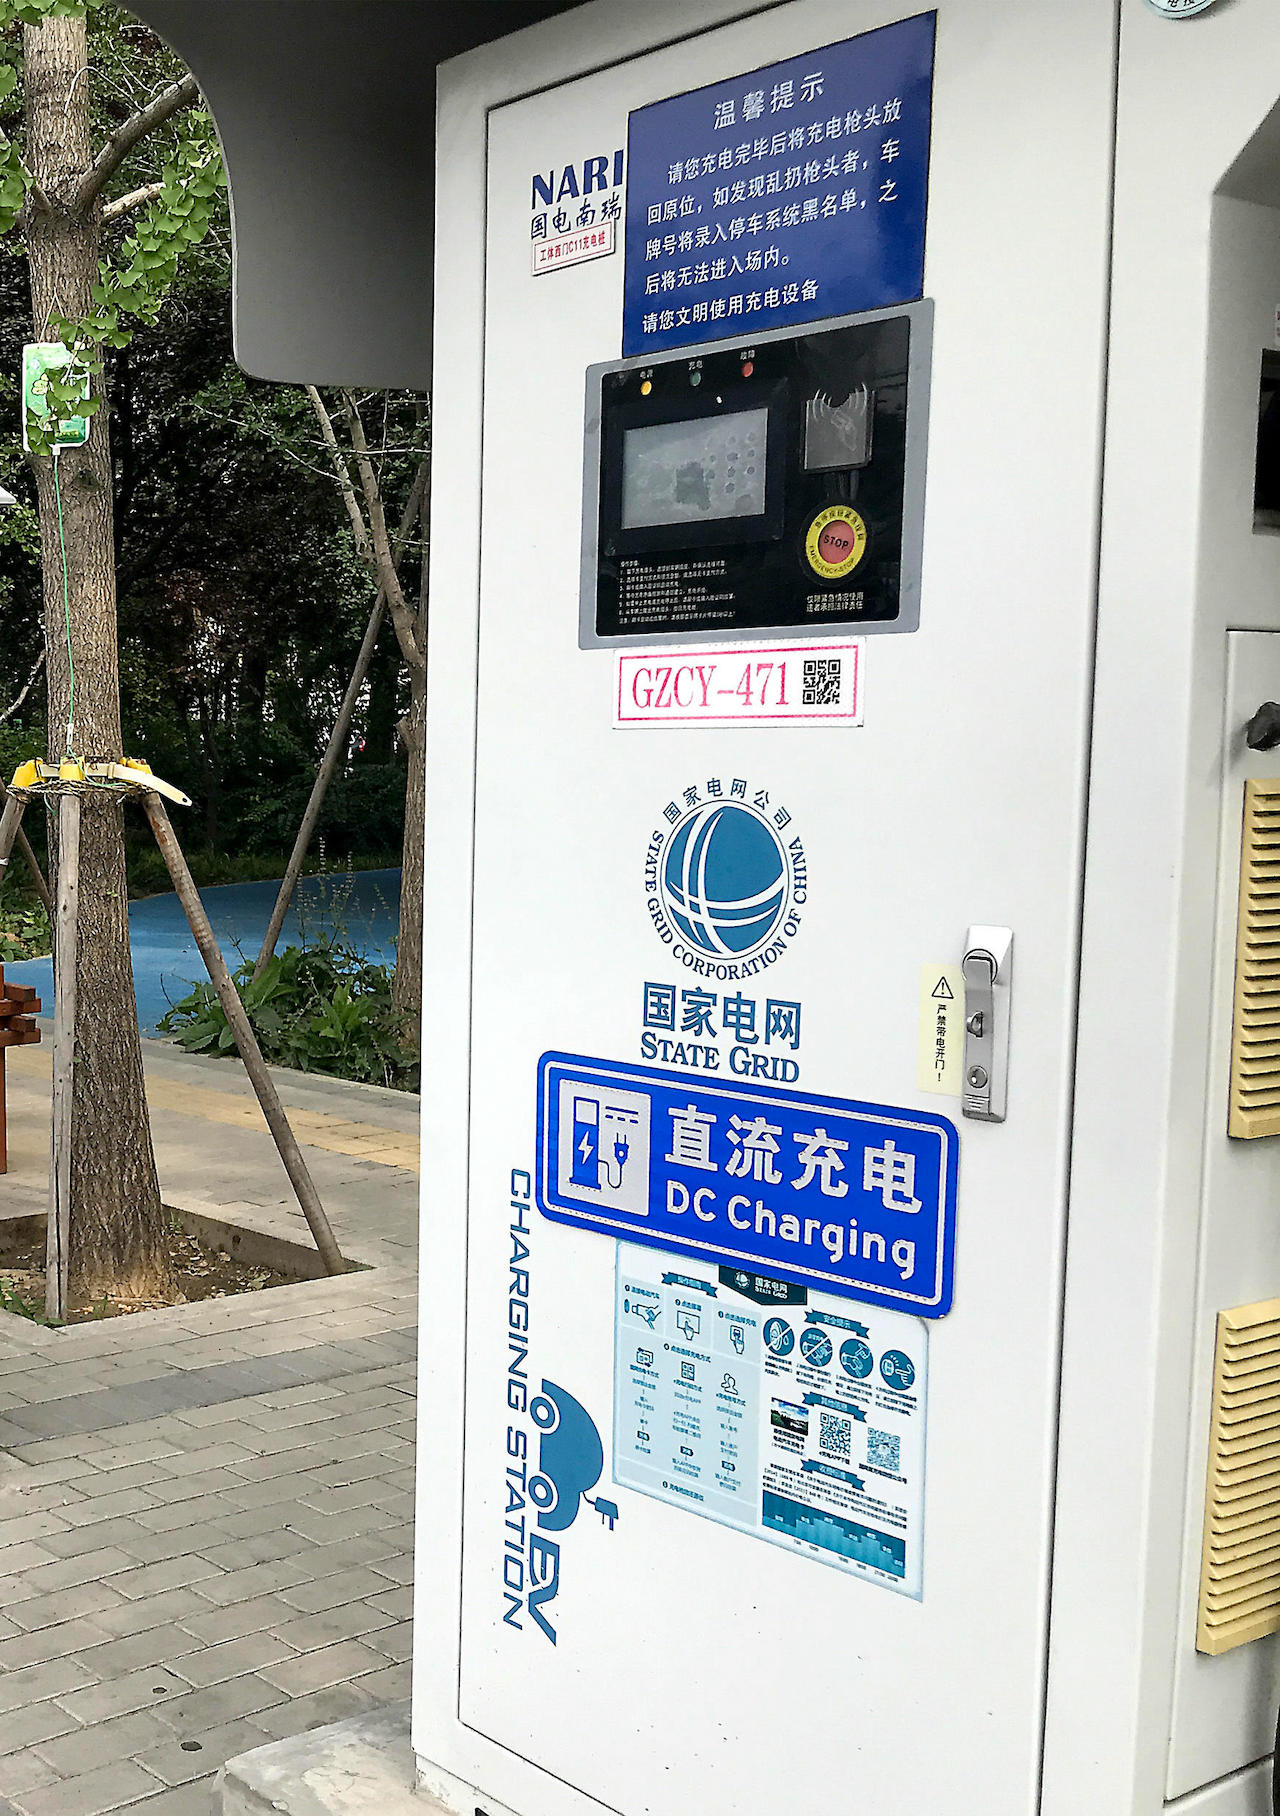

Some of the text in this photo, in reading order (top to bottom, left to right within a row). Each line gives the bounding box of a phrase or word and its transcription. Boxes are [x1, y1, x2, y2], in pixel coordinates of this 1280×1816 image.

[713, 71, 825, 131] 温馨提示
[667, 97, 903, 186] 请您充电完毕后将充电枪头放
[531, 149, 624, 210] NARI
[647, 139, 901, 227] 回原位，如发现乱扔枪头者，车
[531, 191, 622, 240] 国电南瑞
[645, 180, 900, 262] 牌号将录入停车系统黑名单，之
[644, 249, 792, 296] 后将无法进入场内。
[641, 278, 819, 335] 请您文明使用充电设备
[824, 534, 849, 550] STOP
[632, 661, 789, 709] GZCY-471
[663, 777, 792, 831] 国家电网公司
[644, 829, 808, 981] STATE GRID CORPORATION OF CHINA
[643, 981, 802, 1050] 国家电网
[640, 1031, 800, 1083] STATE GRID
[664, 1103, 923, 1215] 直流充电
[666, 1179, 917, 1281] DC Charging
[503, 1167, 531, 1630] CHARGING STATION
[528, 1532, 561, 1648] EV
